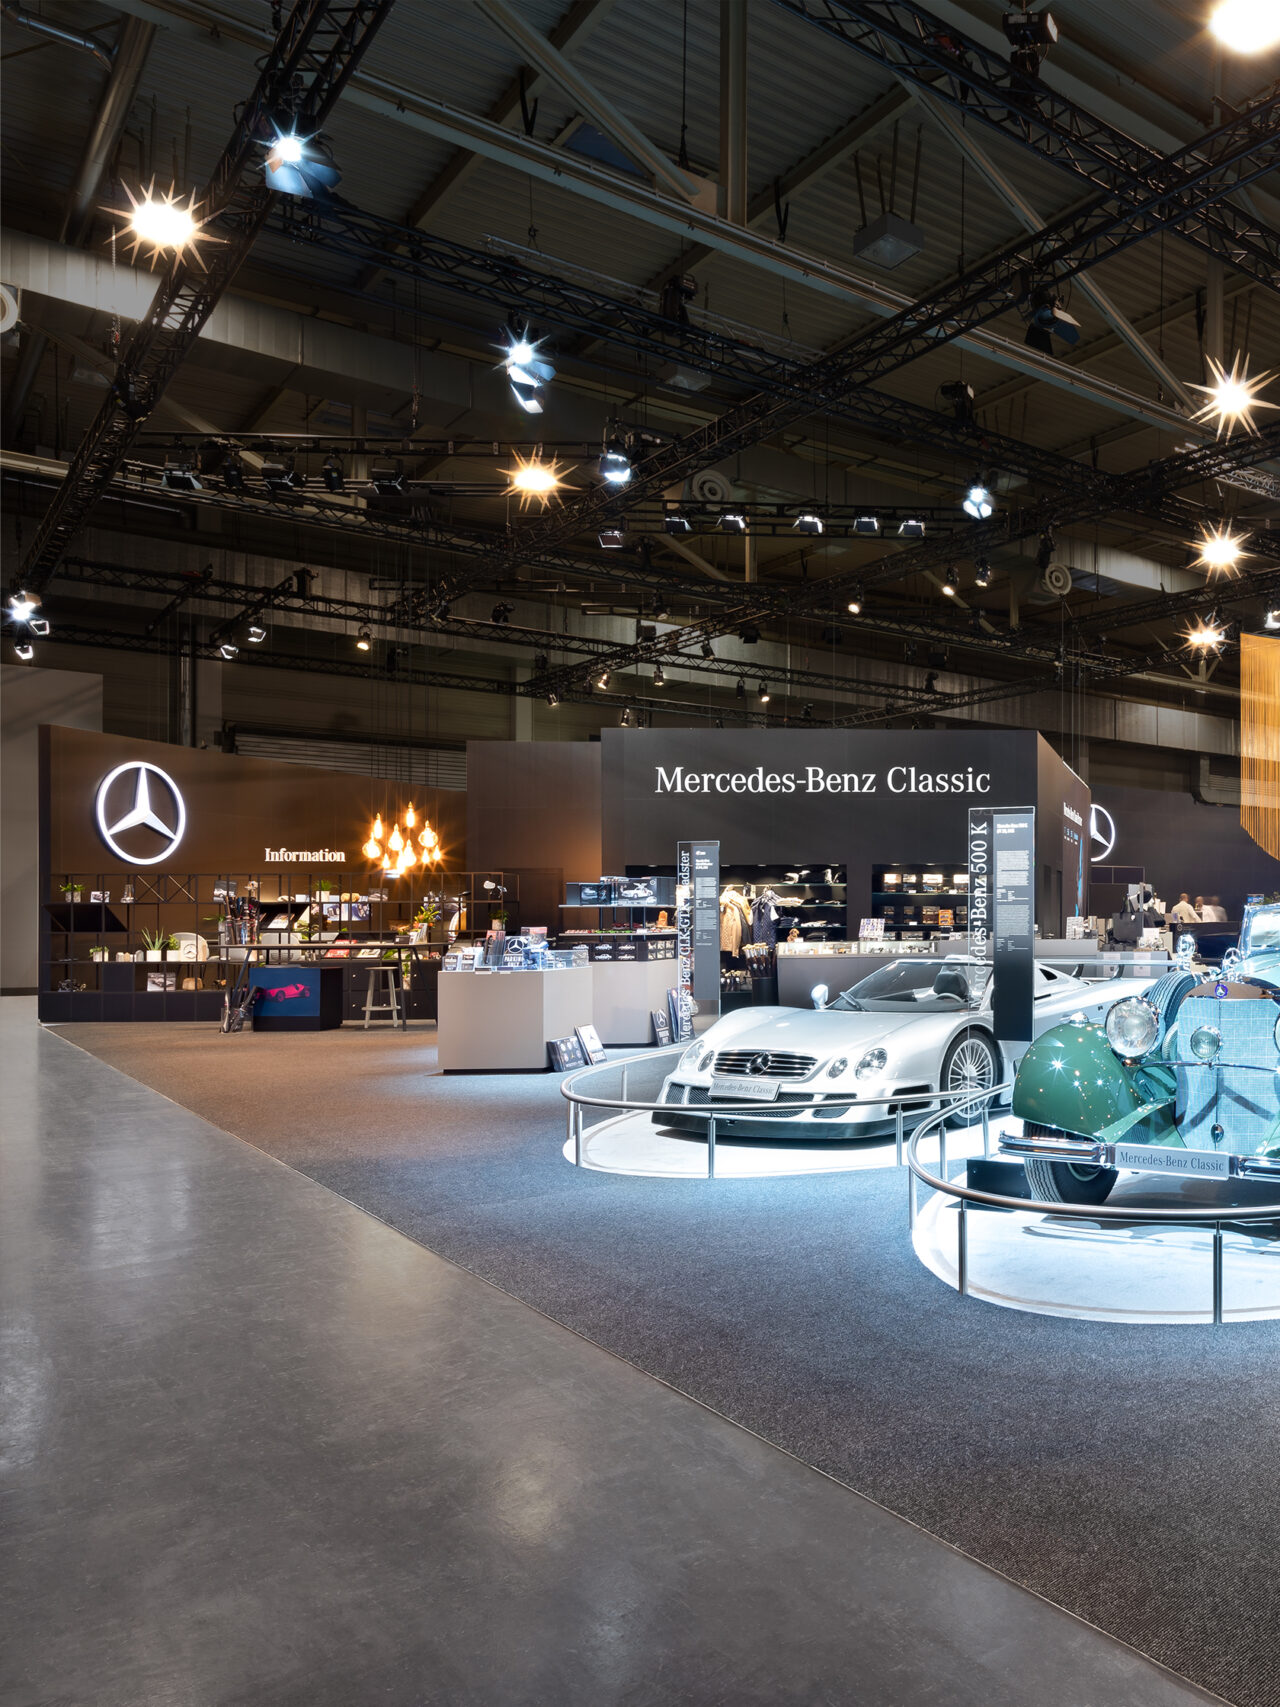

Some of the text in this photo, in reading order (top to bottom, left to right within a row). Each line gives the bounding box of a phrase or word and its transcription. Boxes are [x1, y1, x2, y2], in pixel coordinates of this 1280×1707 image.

[655, 766, 990, 793] Mercedes-Benz Classic
[970, 821, 988, 836] K
[264, 847, 346, 862] Information
[970, 840, 988, 874] 500
[679, 850, 691, 899] adster
[679, 957, 691, 1041] MercedesBenz
[1120, 1151, 1224, 1171] Mercedes-Benz Classic
